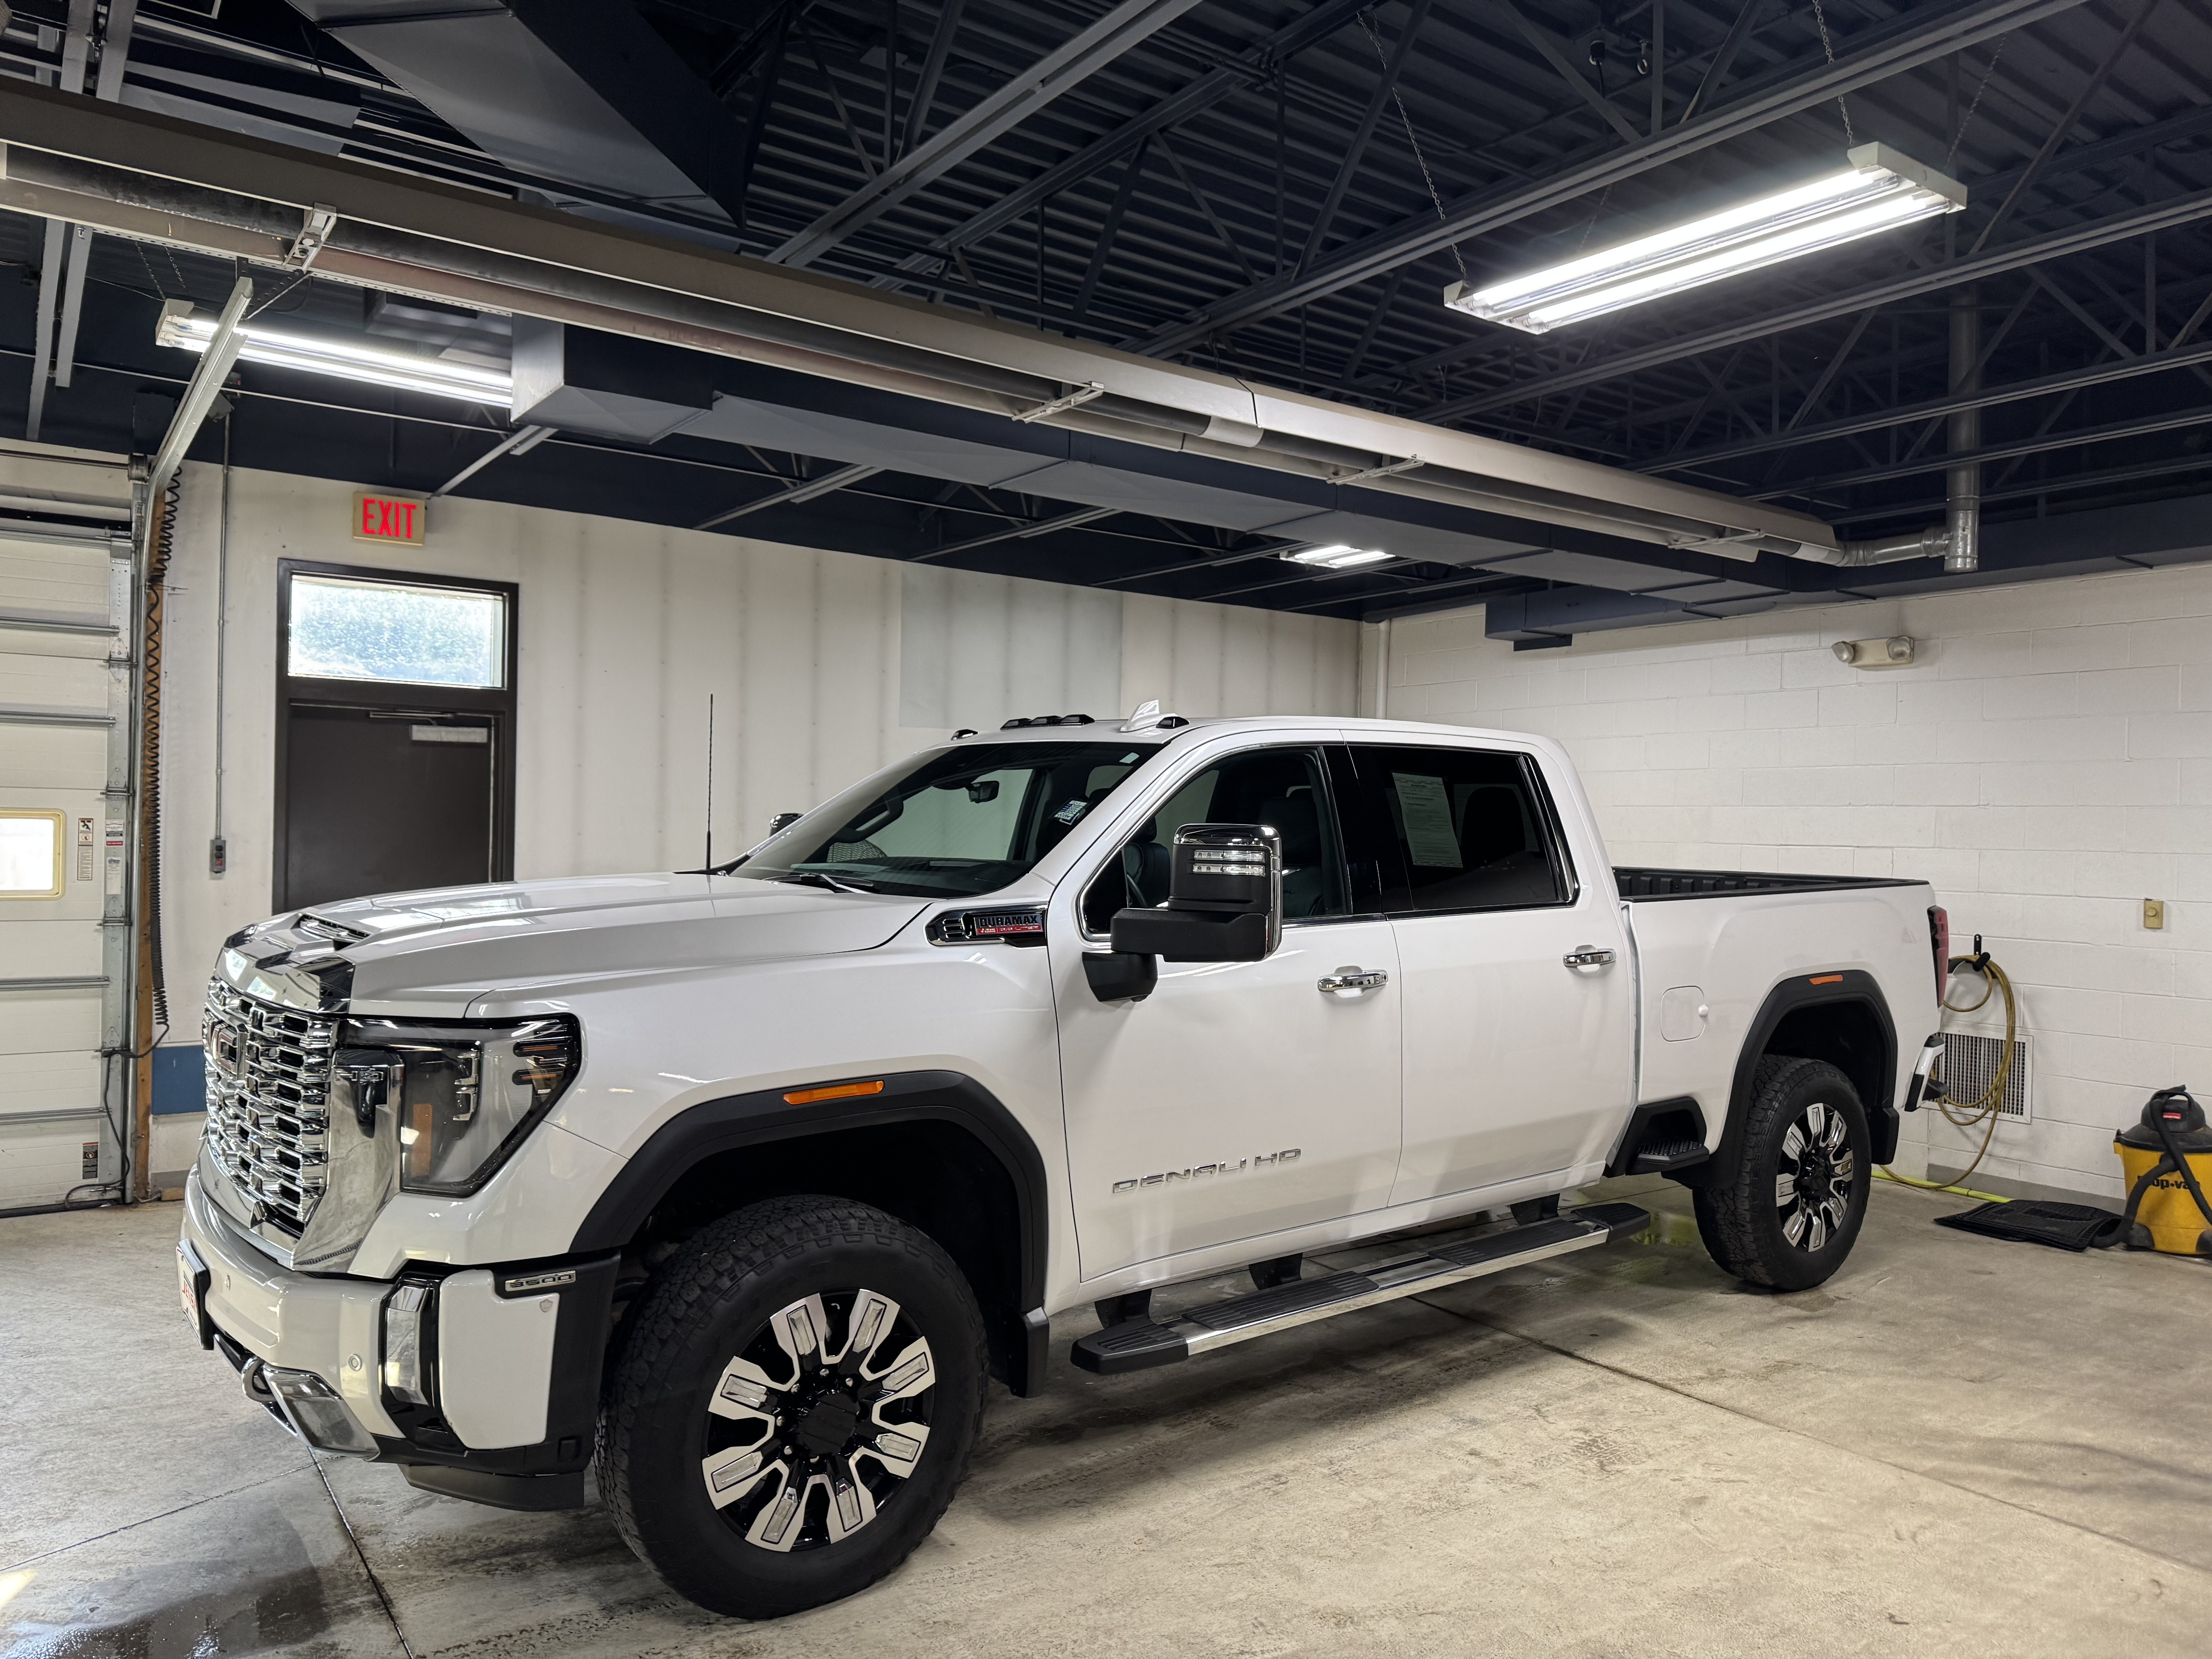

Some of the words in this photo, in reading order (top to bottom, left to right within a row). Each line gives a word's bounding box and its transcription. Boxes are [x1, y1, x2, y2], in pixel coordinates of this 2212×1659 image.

[362, 498, 417, 539] EXIT
[979, 915, 1039, 927] DURAMAX
[1113, 1158, 1247, 1194] DENALI
[1255, 1149, 1301, 1166] HD
[509, 1274, 572, 1288] 3500
